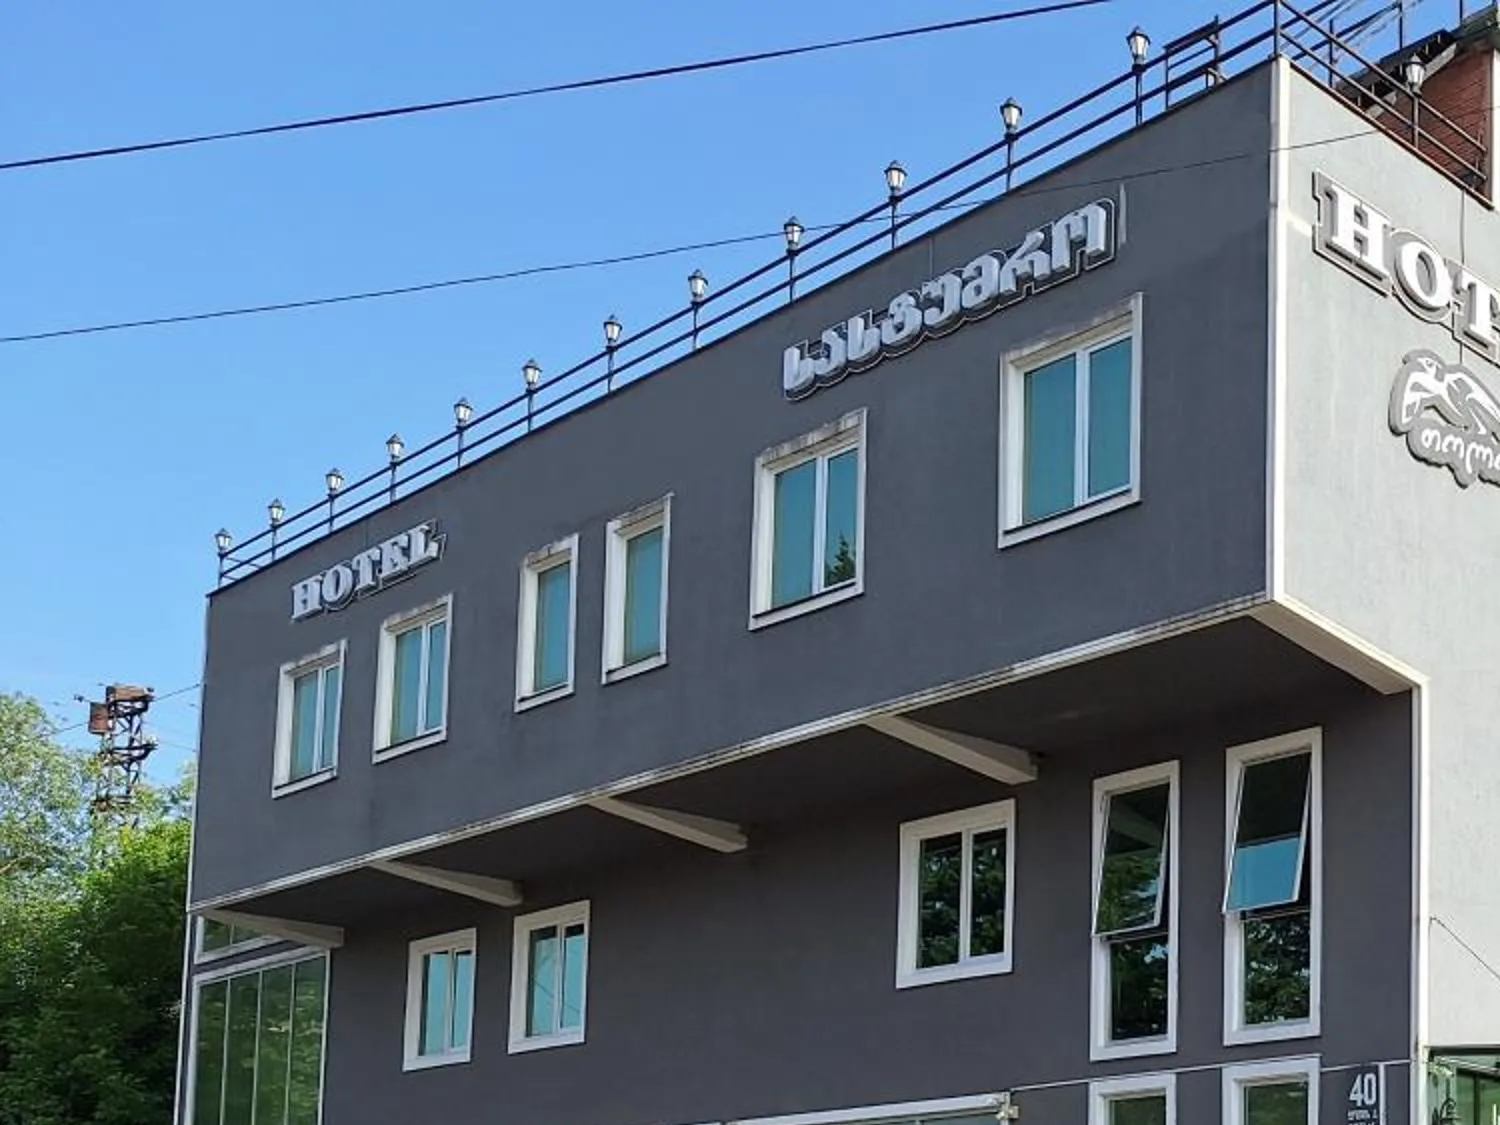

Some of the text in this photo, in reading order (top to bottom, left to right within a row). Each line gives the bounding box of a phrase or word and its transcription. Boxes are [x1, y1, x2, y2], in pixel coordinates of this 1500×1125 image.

[782, 198, 1108, 394] სასტუმრო
[291, 524, 442, 620] HOTEL
[1349, 1072, 1377, 1107] 40
